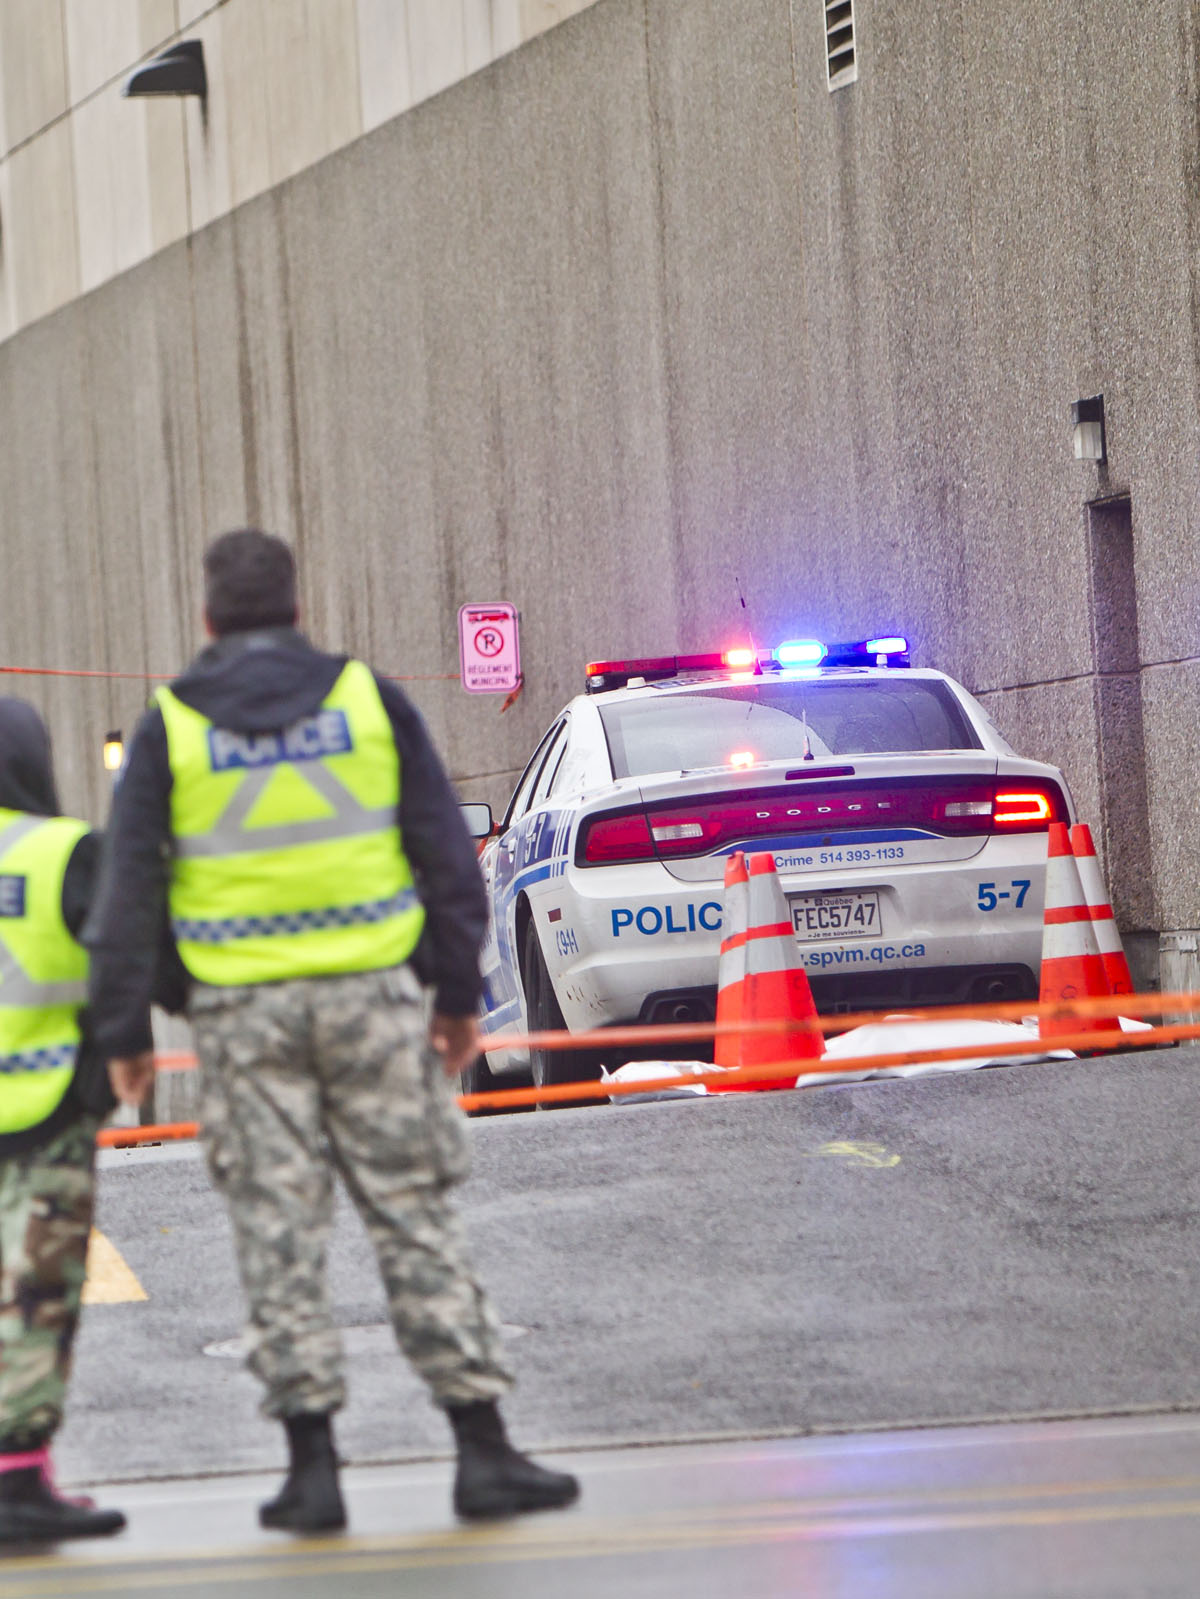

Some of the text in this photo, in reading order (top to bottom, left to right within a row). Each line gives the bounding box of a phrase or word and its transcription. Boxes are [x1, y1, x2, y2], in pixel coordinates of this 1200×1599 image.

[755, 802, 891, 818] DODGE
[820, 852, 843, 864] 514
[846, 847, 905, 862] 393-1133
[977, 879, 1031, 912] 5-7
[611, 902, 723, 937] POLIC
[793, 903, 876, 931] FEC5747
[800, 944, 925, 968] .spvm.qc.ca
